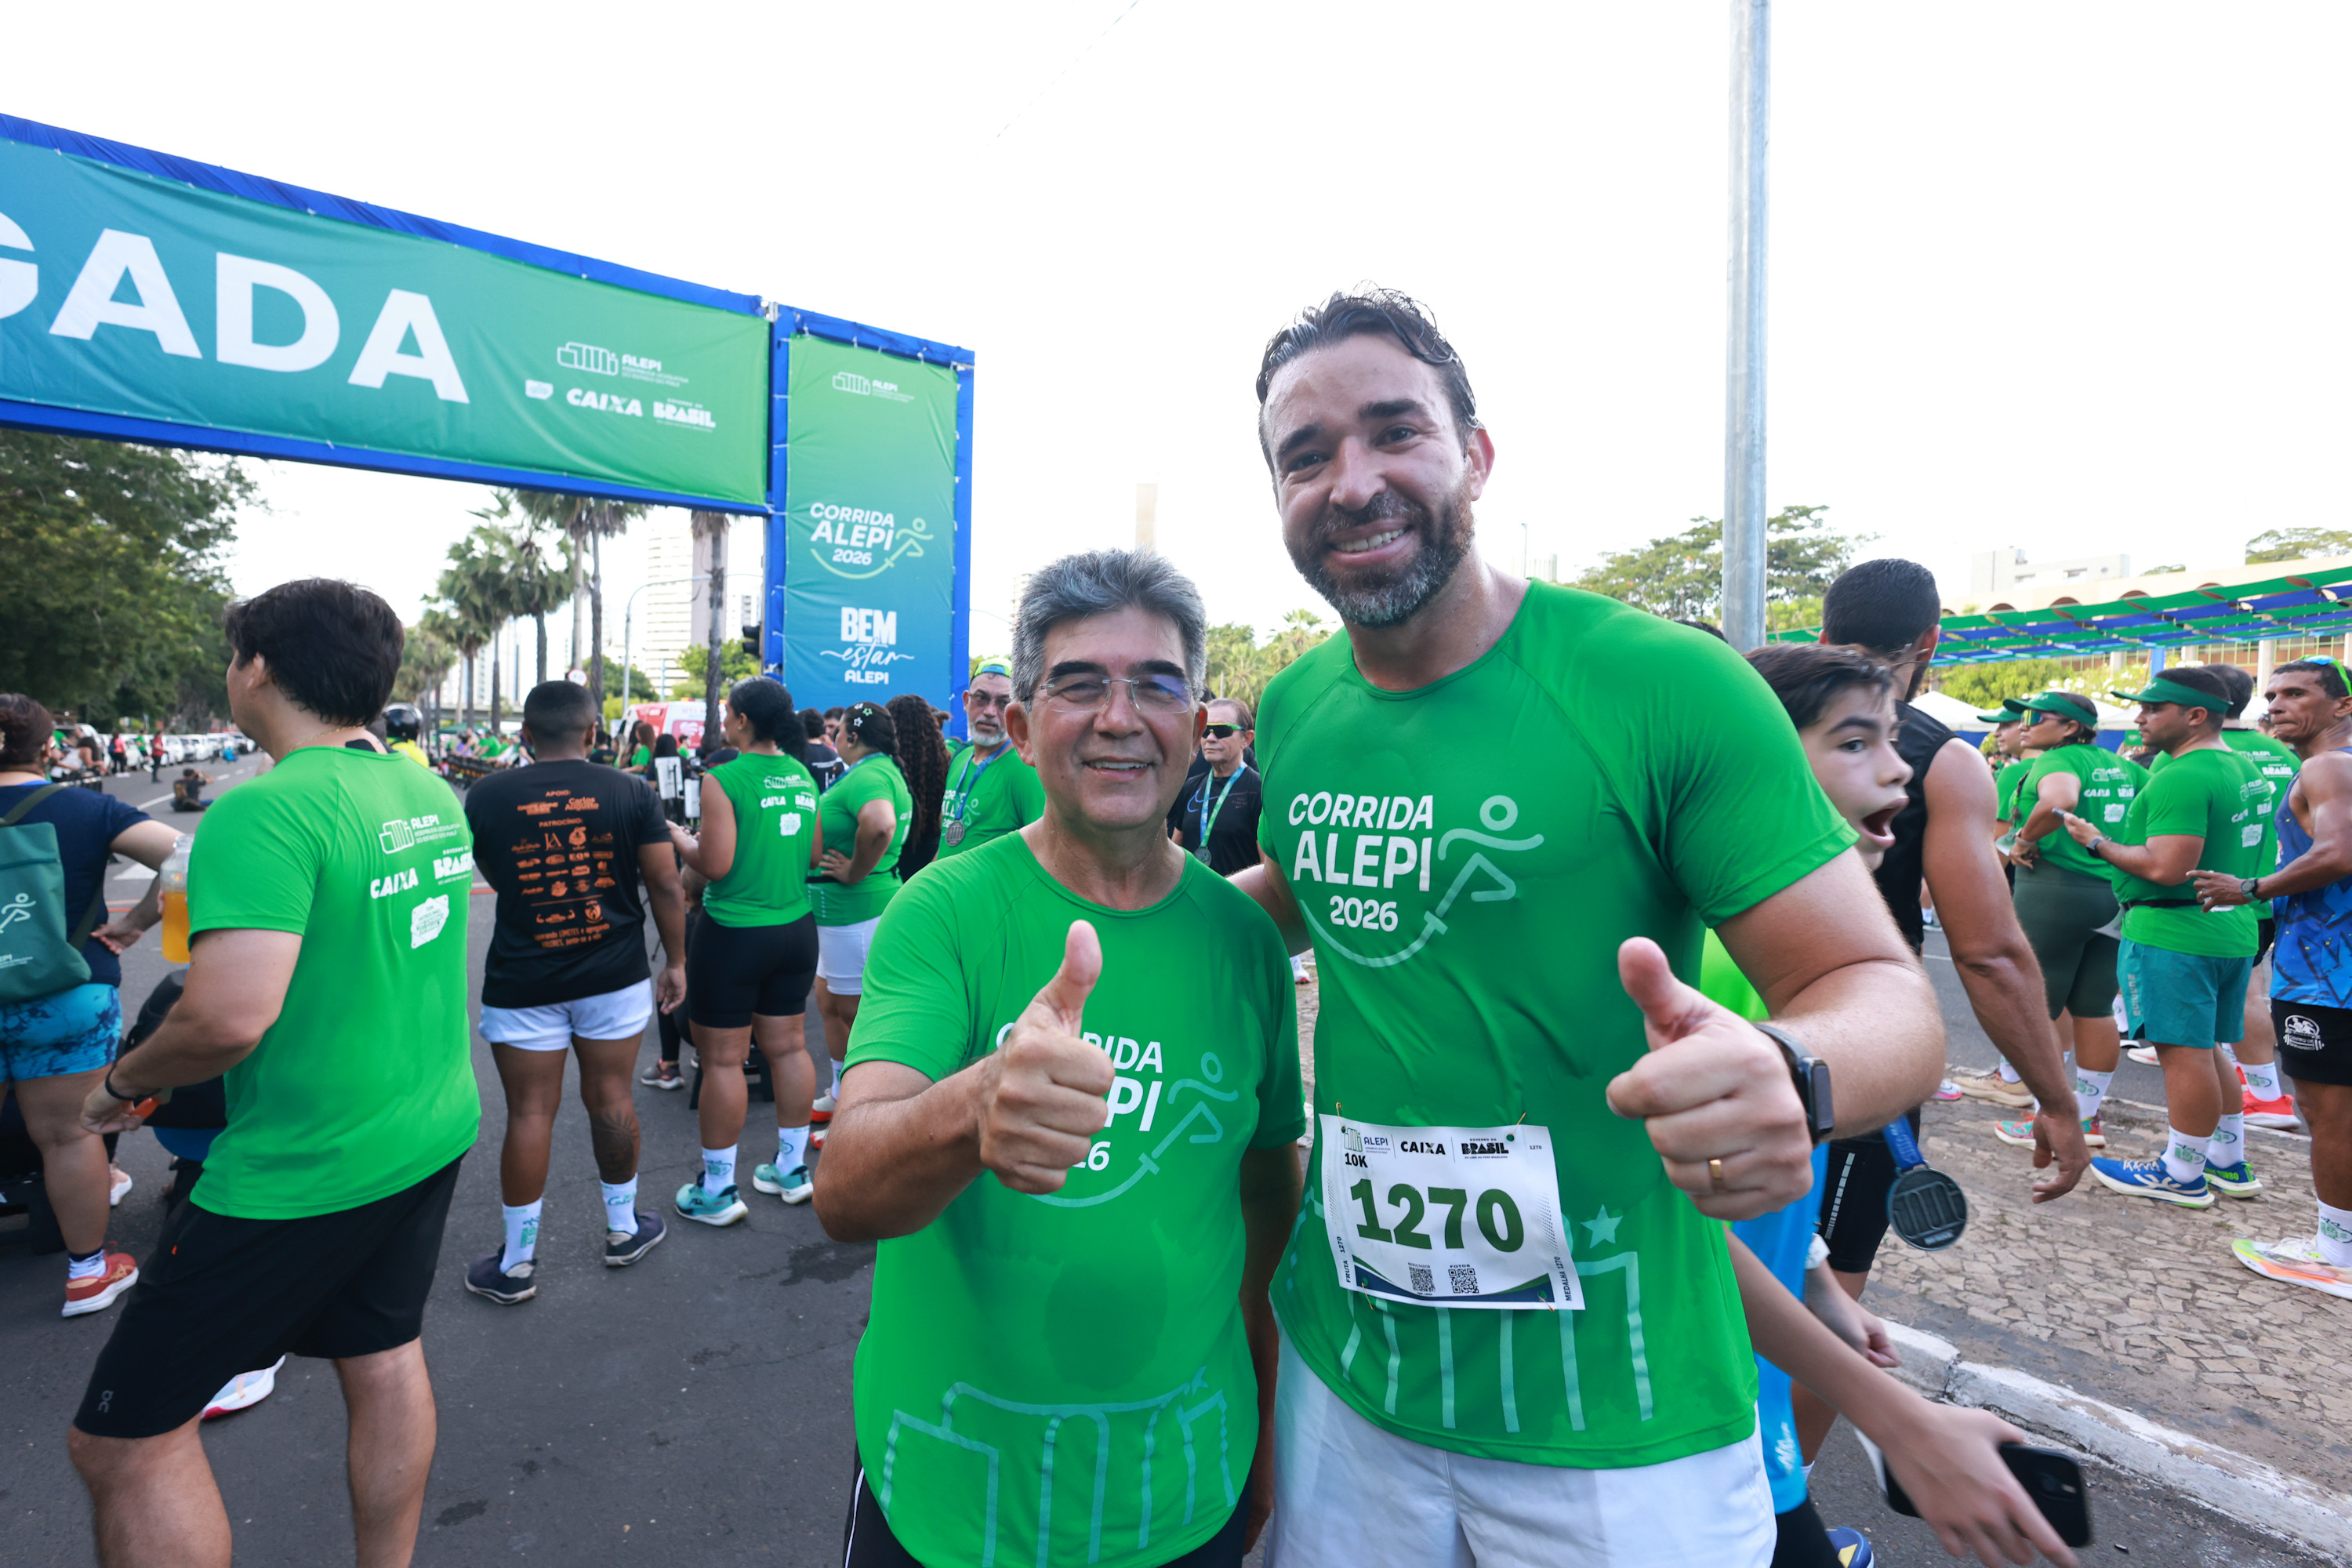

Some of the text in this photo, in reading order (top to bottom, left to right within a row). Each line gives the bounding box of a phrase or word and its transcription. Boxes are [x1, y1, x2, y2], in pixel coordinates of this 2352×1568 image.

[622, 354, 662, 372] ALEPI
[566, 387, 643, 417] CAIXA
[653, 401, 716, 428] BRASIL
[809, 502, 895, 528] CORRIDA
[810, 520, 895, 551] ALEPI
[832, 548, 873, 566] 2026
[840, 606, 897, 645] BEM
[820, 637, 915, 670] estar
[844, 670, 889, 684] ALEPI
[410, 814, 440, 829] ALEPI
[1288, 791, 1434, 832] CORRIDA
[433, 851, 473, 880] BRASI
[1292, 829, 1433, 892] ALEPI
[370, 867, 419, 899] CAIXA
[1330, 895, 1399, 932] 2026
[996, 1022, 1163, 1073] CIDA
[1363, 1137, 1388, 1146] ALEPI
[1400, 1141, 1446, 1155] CAIXA
[1461, 1142, 1509, 1155] BRASIL
[1345, 1152, 1368, 1168] 10K
[1349, 1177, 1525, 1253] 1270
[1336, 1236, 1345, 1254] 1270
[1554, 1256, 1573, 1301] MEDALHA 1270
